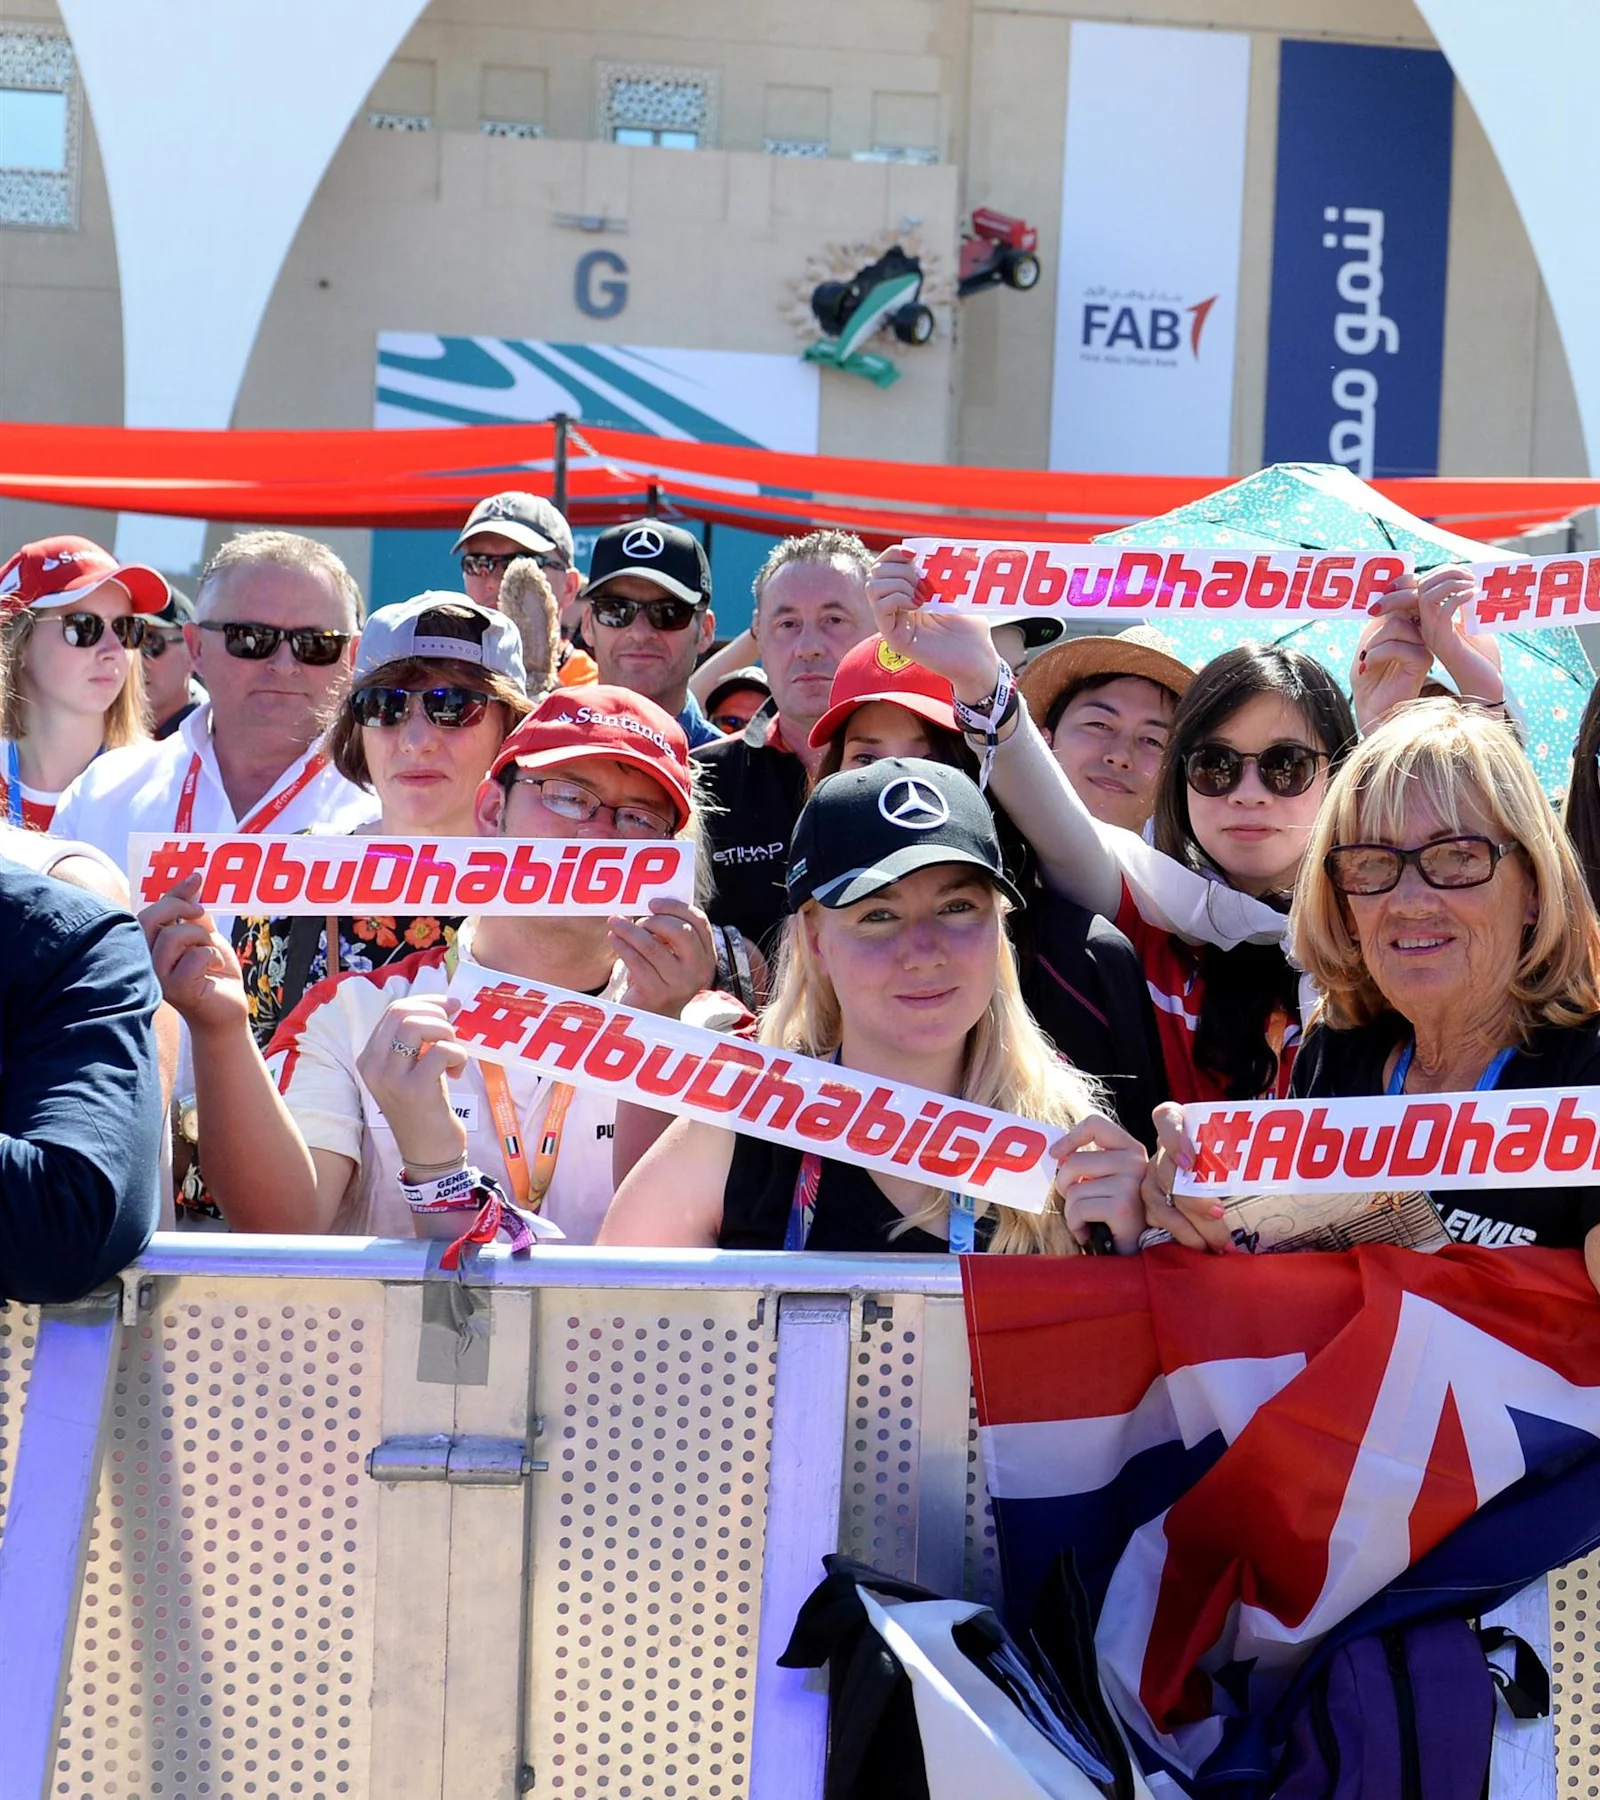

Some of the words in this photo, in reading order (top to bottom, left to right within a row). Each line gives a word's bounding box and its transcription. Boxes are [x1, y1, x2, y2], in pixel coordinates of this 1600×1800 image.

[575, 249, 628, 320] G
[1081, 303, 1181, 351] FAB
[141, 841, 682, 904] #AbuDhabiGP
[452, 980, 1048, 1188] #AbuDhabiGP
[1436, 1203, 1537, 1248] EWIS
